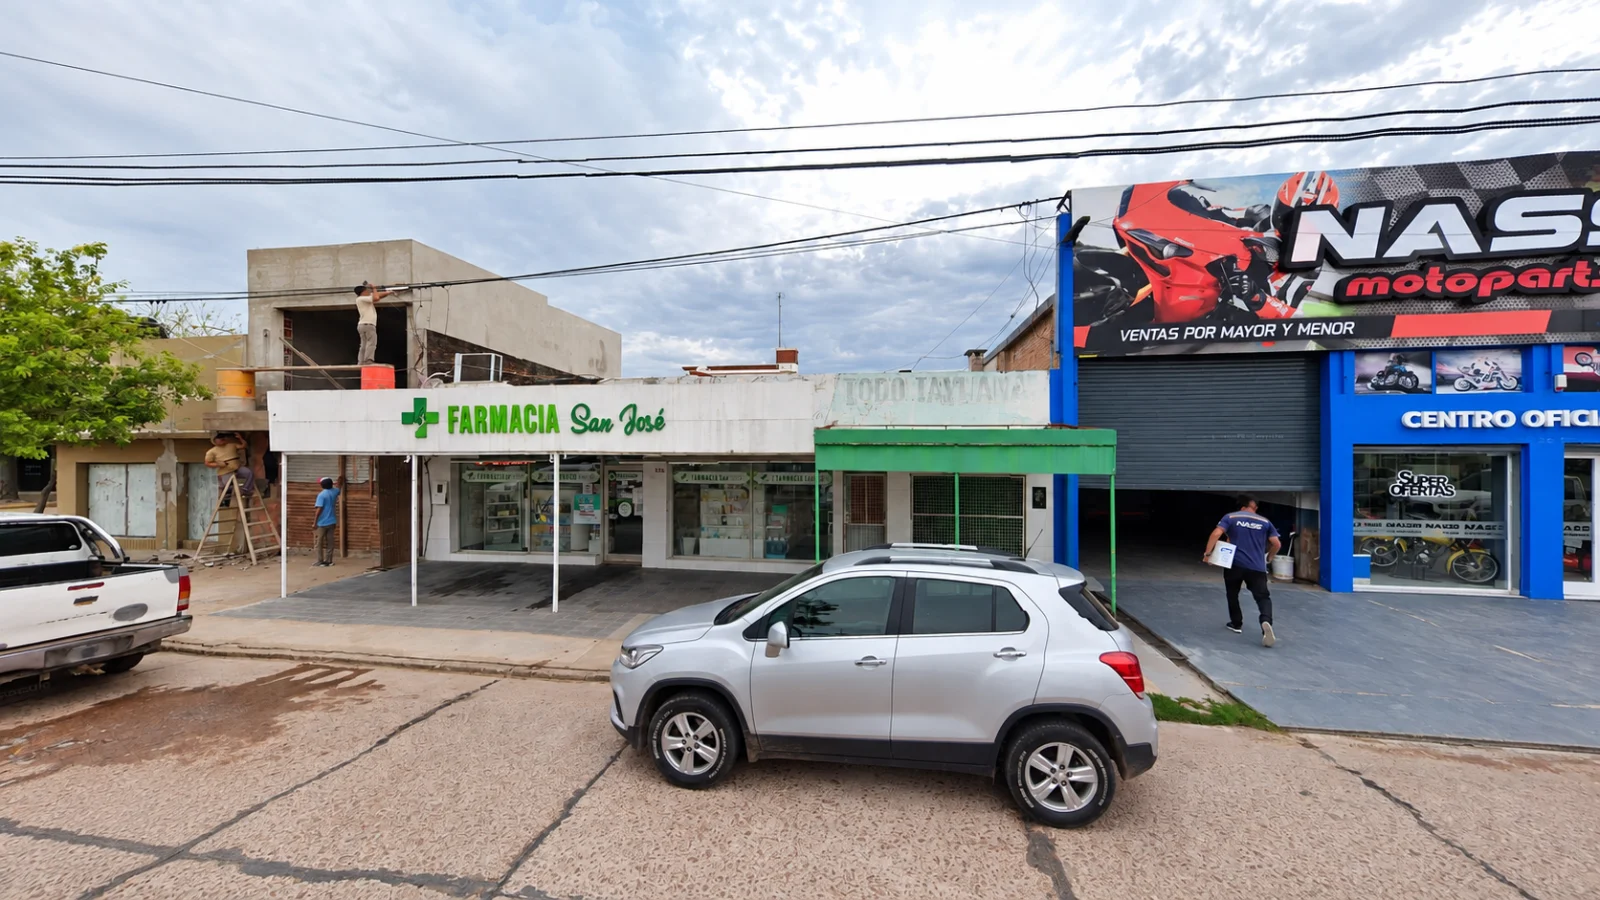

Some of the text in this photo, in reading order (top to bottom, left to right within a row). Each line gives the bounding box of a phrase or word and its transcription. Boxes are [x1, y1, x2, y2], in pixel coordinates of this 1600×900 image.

[1120, 321, 1355, 342] VENTAS POR MAYOR Y MENOR
[448, 402, 666, 436] FARMACIA San José
[1401, 409, 1600, 428] CENTRO OFICI
[1398, 470, 1448, 486] SUPER
[1389, 484, 1455, 497] OFERTAS
[1236, 520, 1264, 530] NASS
